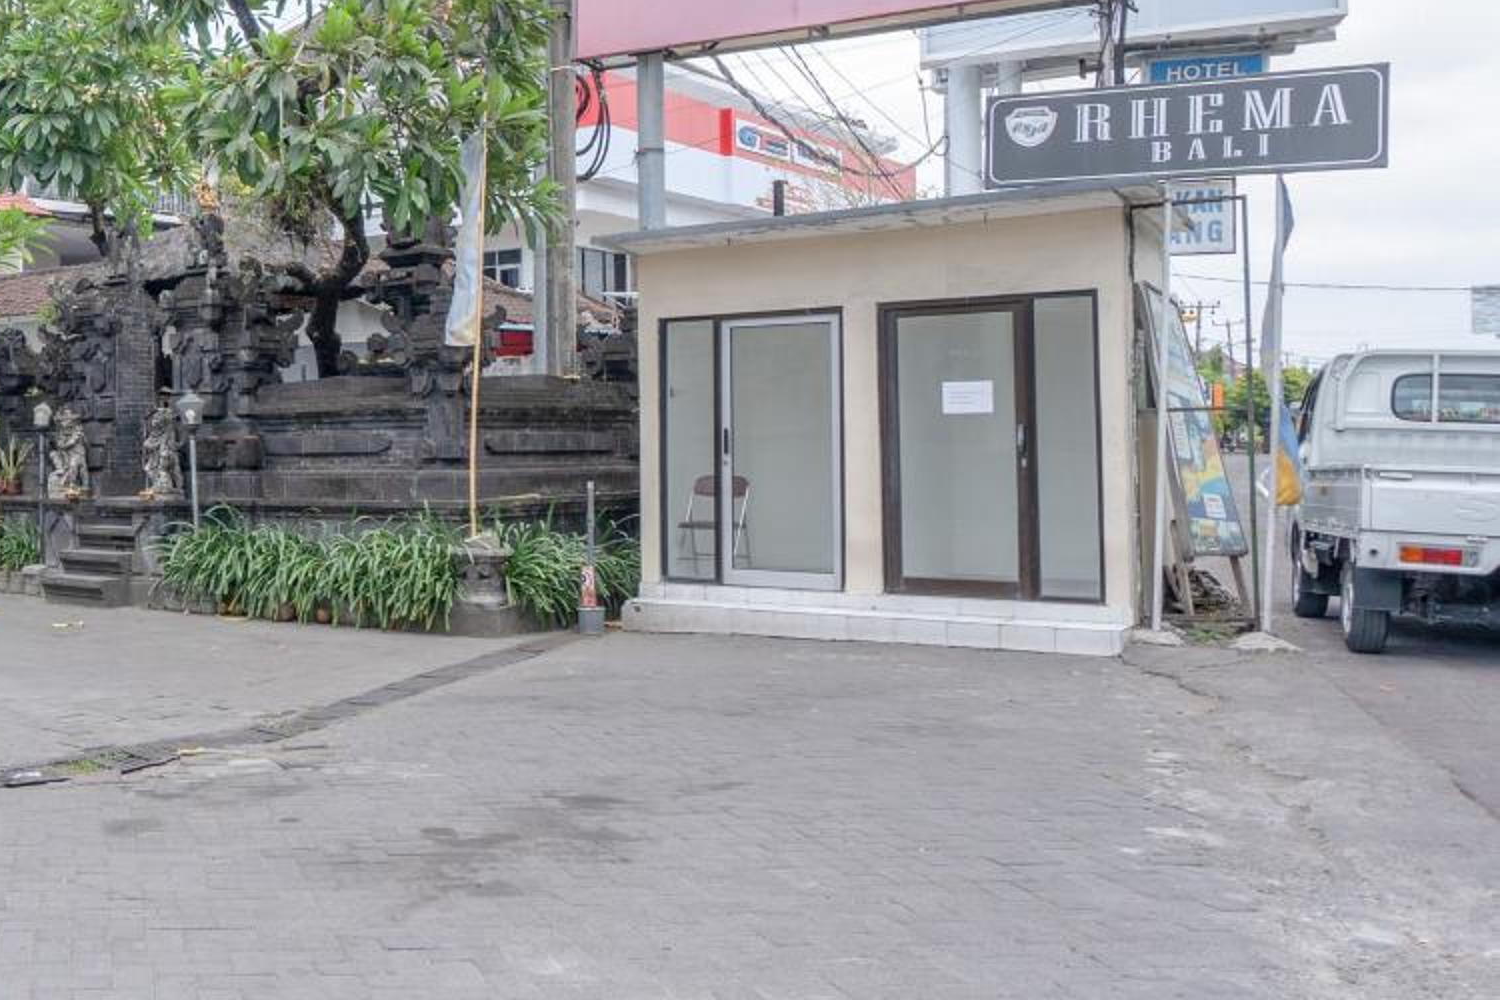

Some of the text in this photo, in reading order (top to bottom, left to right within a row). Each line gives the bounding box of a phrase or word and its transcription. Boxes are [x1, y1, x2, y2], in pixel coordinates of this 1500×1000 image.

[1166, 61, 1247, 82] HOTEL
[1072, 83, 1351, 143] RHEMA
[1151, 134, 1272, 164] BALI
